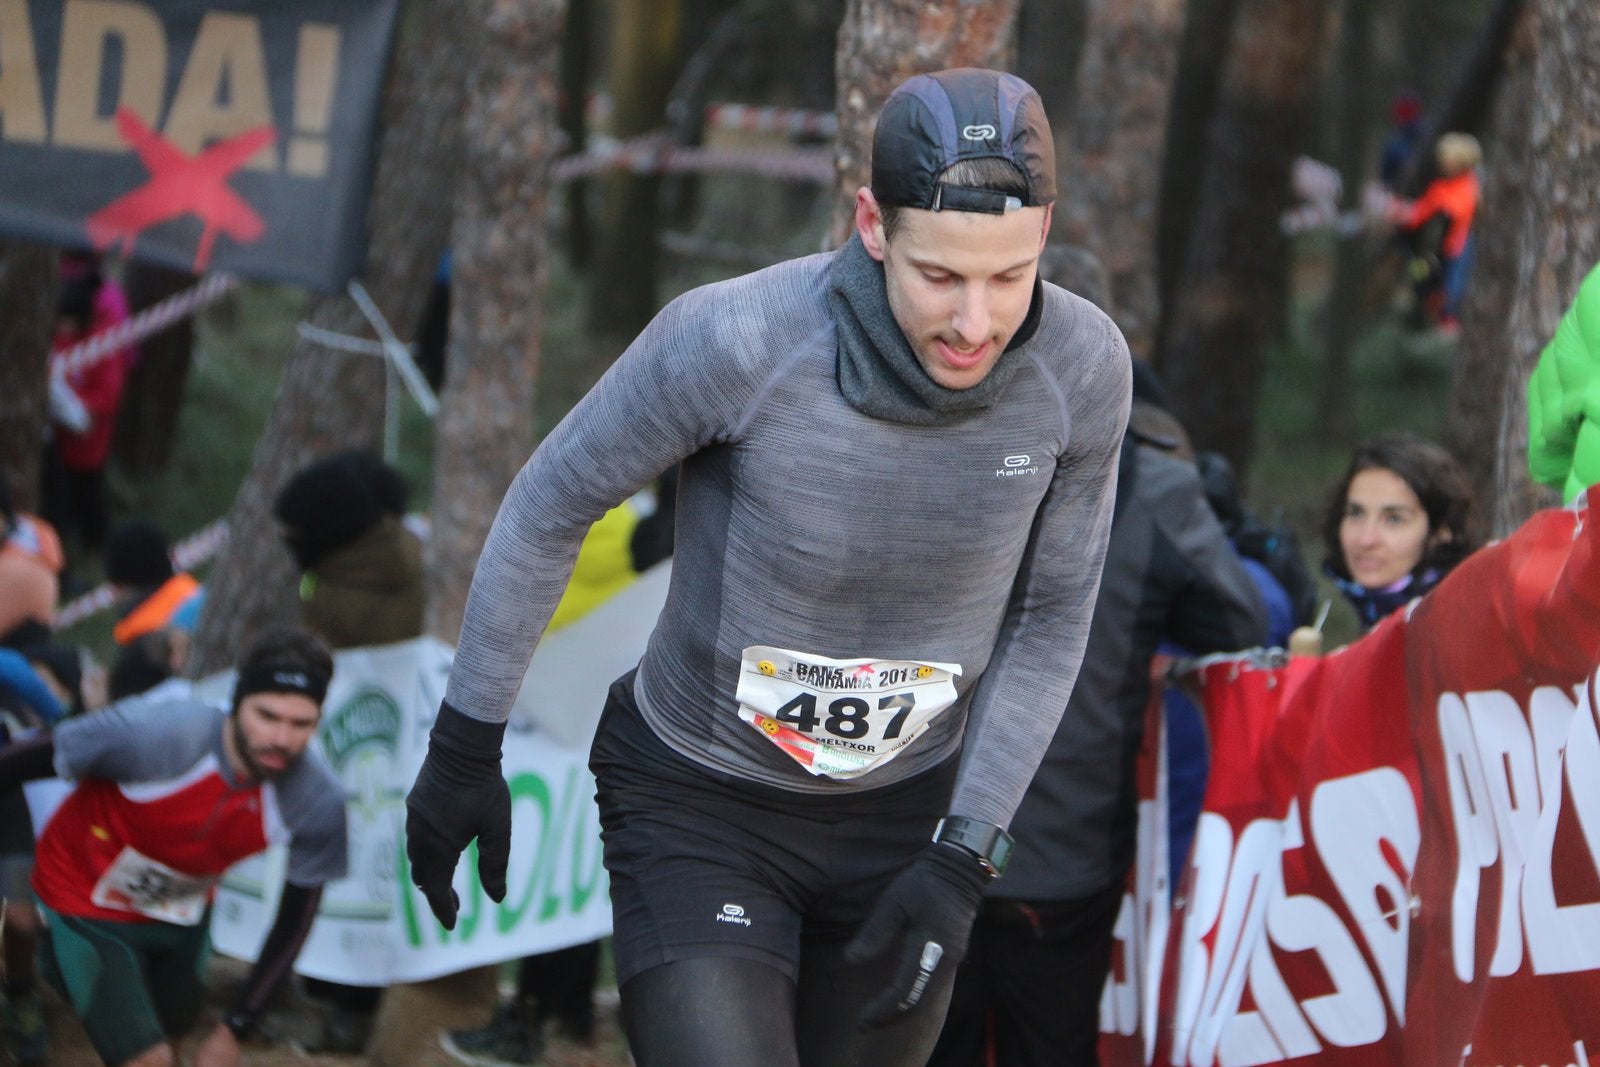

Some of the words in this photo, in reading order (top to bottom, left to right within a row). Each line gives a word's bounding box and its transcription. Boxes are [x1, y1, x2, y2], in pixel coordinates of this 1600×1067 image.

[996, 466, 1038, 477] Kalenji
[775, 692, 916, 740] 487
[815, 737, 876, 753] MELTXOR
